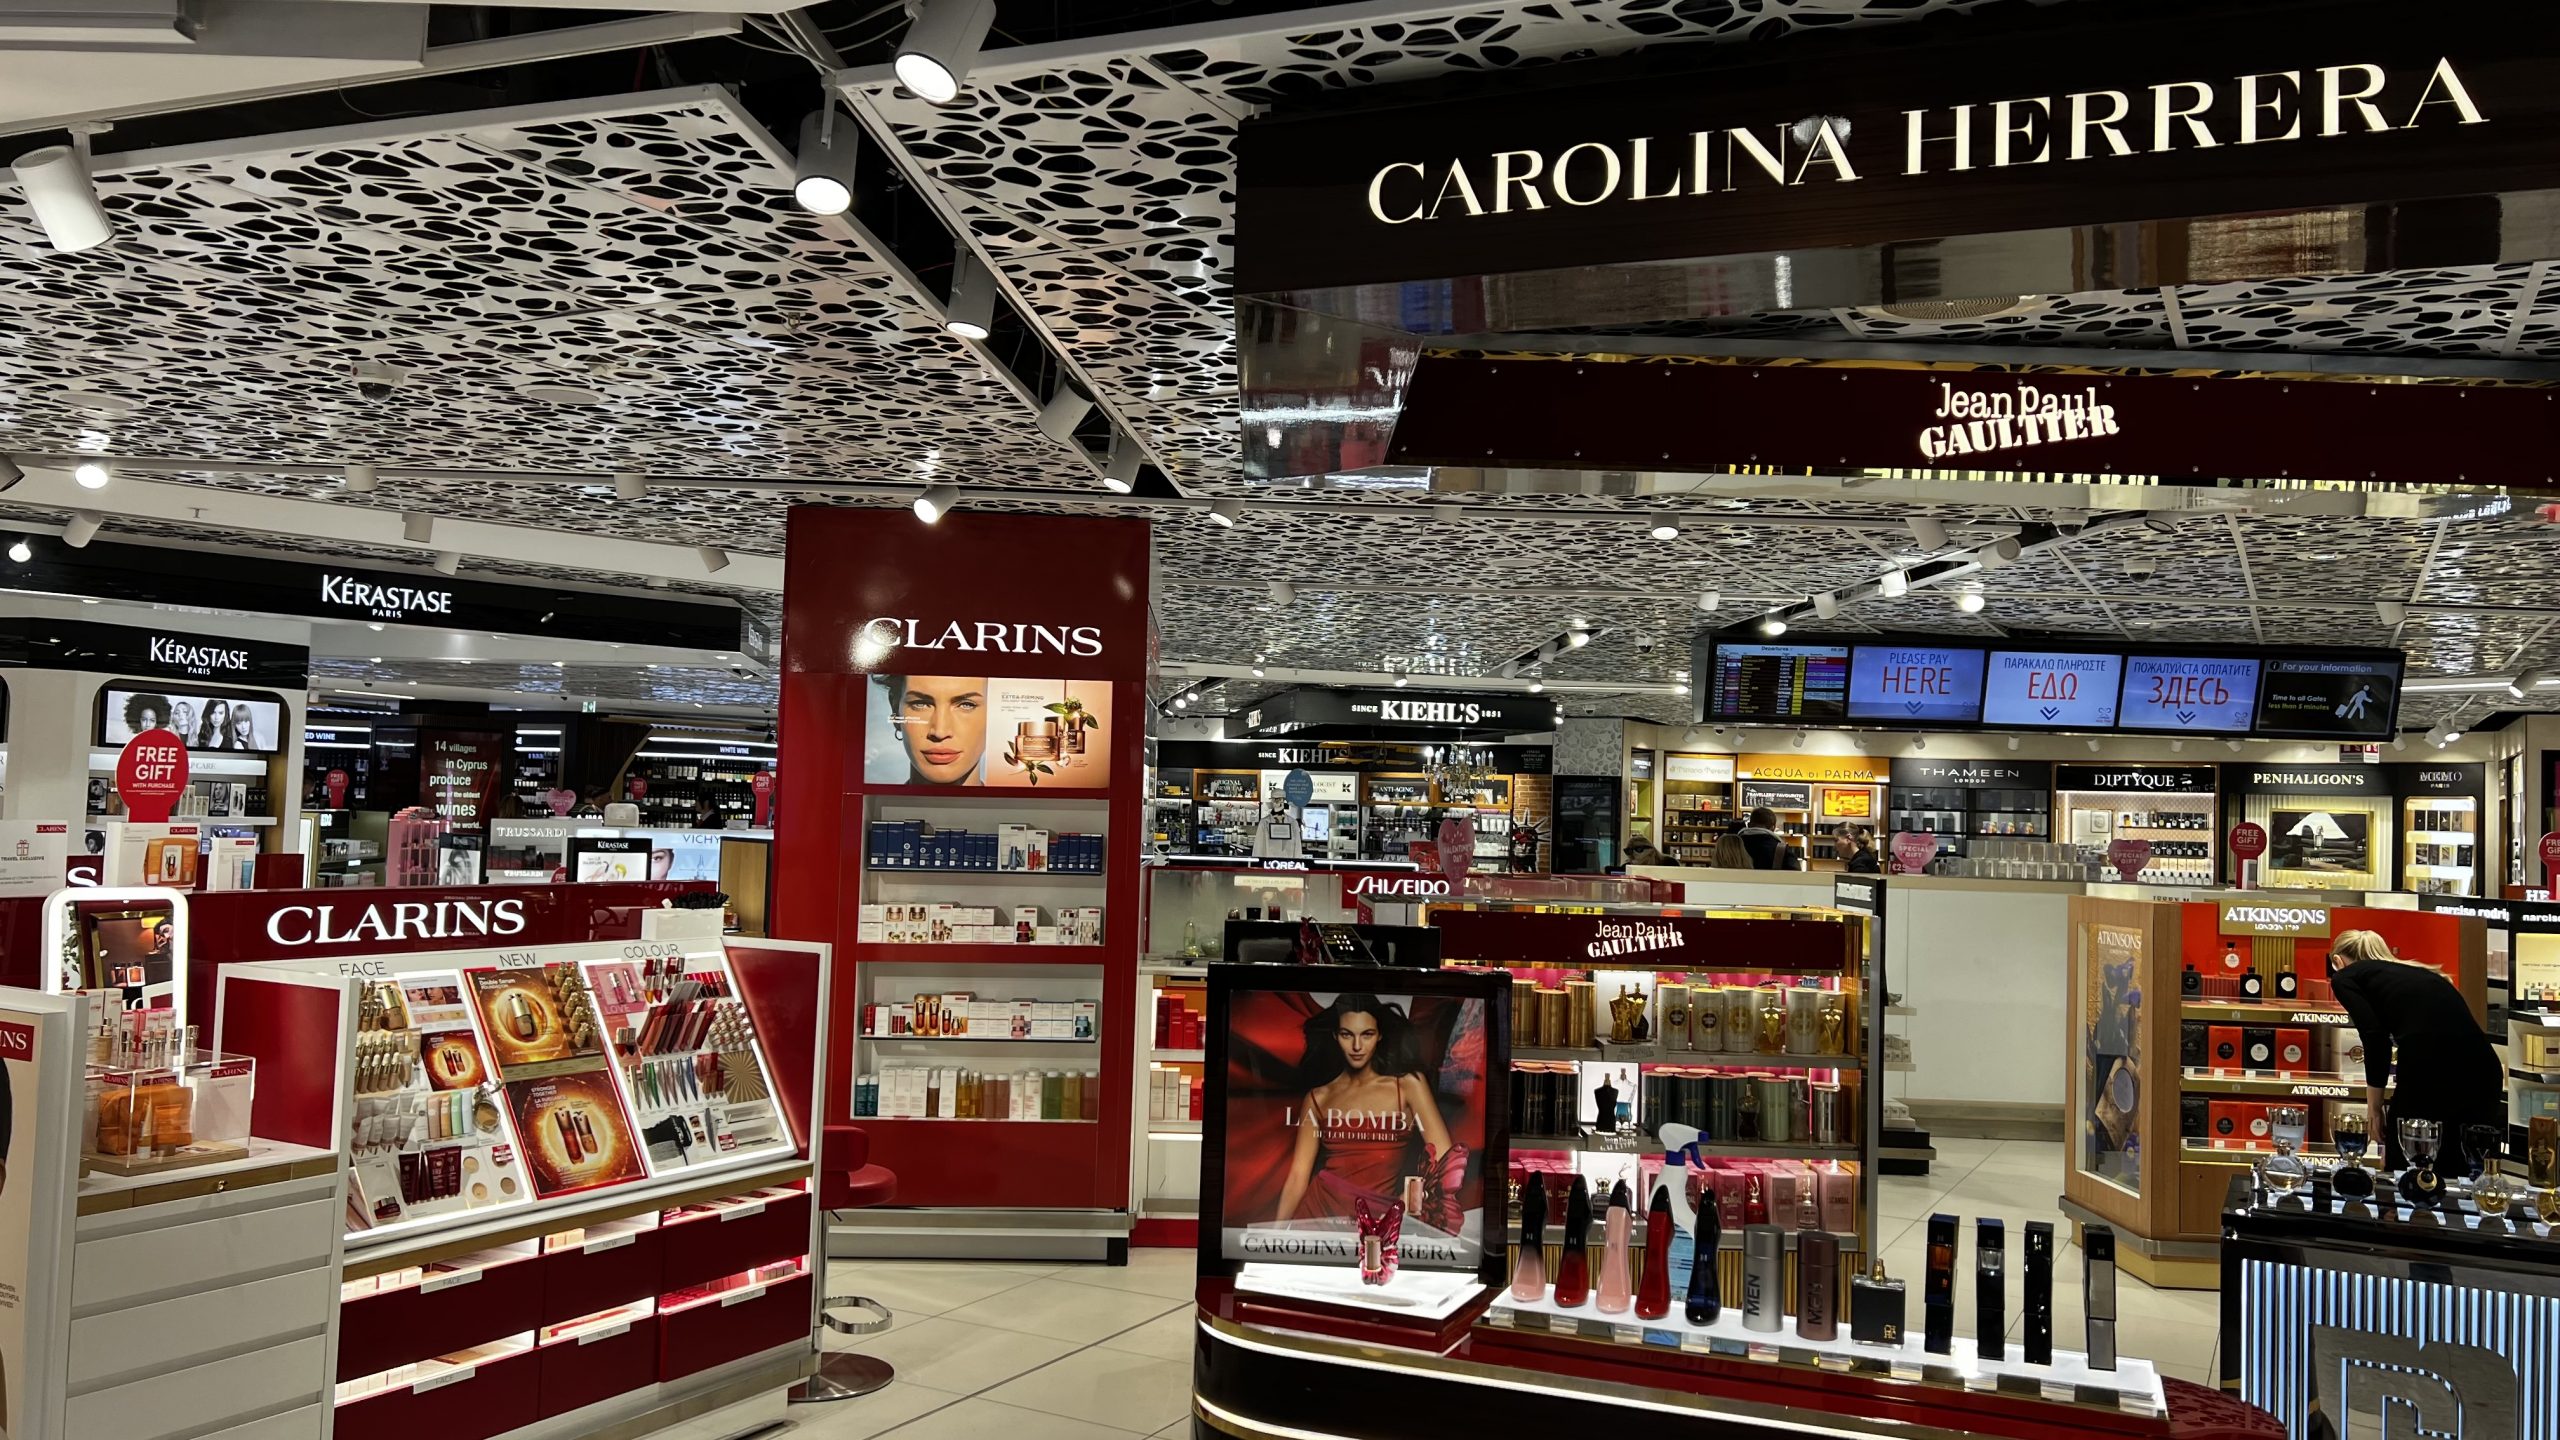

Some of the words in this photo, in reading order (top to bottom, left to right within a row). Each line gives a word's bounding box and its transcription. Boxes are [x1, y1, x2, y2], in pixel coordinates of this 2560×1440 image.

[1367, 115, 1857, 224] CAROLINA
[1901, 56, 2491, 176] HERRERA
[1936, 382, 2015, 419] Jean
[2018, 385, 2097, 420] Paul
[1919, 404, 2120, 459] GAULTIER
[322, 574, 453, 614] KÉRASTASE
[372, 609, 402, 618] PARIS
[864, 617, 1103, 657] CLARINS
[150, 636, 248, 670] KÉRASTASE
[1890, 652, 1925, 664] PLEASE
[1929, 653, 1950, 666] PAY
[188, 667, 211, 675] PARIS
[2004, 657, 2055, 670] ΠΑΡΑΚΑΛΩ
[2056, 659, 2107, 672] ΠΛΗΡΩΣΤΕ
[2134, 661, 2199, 674] ПОЖАЛУЙСТА
[2201, 663, 2251, 677] ОПЛАТИТЕ
[2298, 664, 2318, 672] your
[2320, 663, 2372, 673] Information
[1882, 666, 1953, 695] HERE
[2028, 671, 2079, 701] ΕΔΩ
[2147, 675, 2229, 709] ЗДЕСЬ
[1351, 704, 1378, 713] SINCE
[1381, 700, 1480, 724] KIEHL'S
[1481, 710, 1501, 718] 1851
[305, 732, 315, 740] ED
[316, 732, 336, 740] WINE
[434, 740, 447, 751] 14
[449, 743, 477, 753] villages
[719, 746, 737, 754] WHITE
[135, 746, 178, 763] FREE
[445, 759, 455, 769] in
[456, 758, 488, 771] Cyprus
[135, 765, 175, 781] GIFT
[1753, 768, 1804, 778] ACQUA
[1824, 769, 1875, 780] PARMA
[1920, 767, 2020, 778] THAMEEN
[2253, 773, 2365, 786] PENHALIGON'S
[430, 774, 471, 787] produce
[2094, 773, 2175, 788] DIPTYQUE
[463, 791, 481, 799] oldest
[436, 803, 476, 817] wines
[496, 827, 567, 838] TRUSSARDI
[683, 834, 721, 844] VICHY
[2236, 829, 2259, 837] FREE
[597, 841, 629, 849] KÉRASTASE
[2236, 836, 2257, 845] GIFT
[1899, 845, 1929, 853] SPECIAL
[1905, 851, 1922, 859] GIFT
[1264, 860, 1309, 870] L'ORÉAL
[1347, 876, 1450, 895] SHISEIDO
[2225, 906, 2326, 925] ATKINSONS
[2435, 905, 2476, 916] narciso
[267, 899, 526, 946] CLARINS
[1595, 920, 1633, 938] Jean
[1635, 921, 1674, 938] Paul
[1587, 931, 1685, 958] GAULTIER
[2097, 930, 2142, 949] ATKINSONS
[624, 944, 680, 959] COLOUR
[500, 953, 537, 968] NEW
[339, 961, 387, 977] FACE
[604, 1003, 631, 1014] LOVE
[2291, 1012, 2350, 1024] ATKINSONS
[211, 1067, 249, 1077] CLARINS
[2291, 1085, 2350, 1097] ATKINSONS
[1285, 1106, 1318, 1127] LA
[1327, 1108, 1425, 1132] BOMBA
[1313, 1130, 1322, 1139] BE
[1328, 1131, 1355, 1140] LOUD
[1357, 1132, 1370, 1140] BE
[1372, 1132, 1398, 1142] FREE
[1244, 1237, 1347, 1258] CAROLINA
[1353, 1243, 1457, 1261] RERA
[1747, 1274, 1760, 1316] MEN
[1807, 1282, 1822, 1325] MEN
